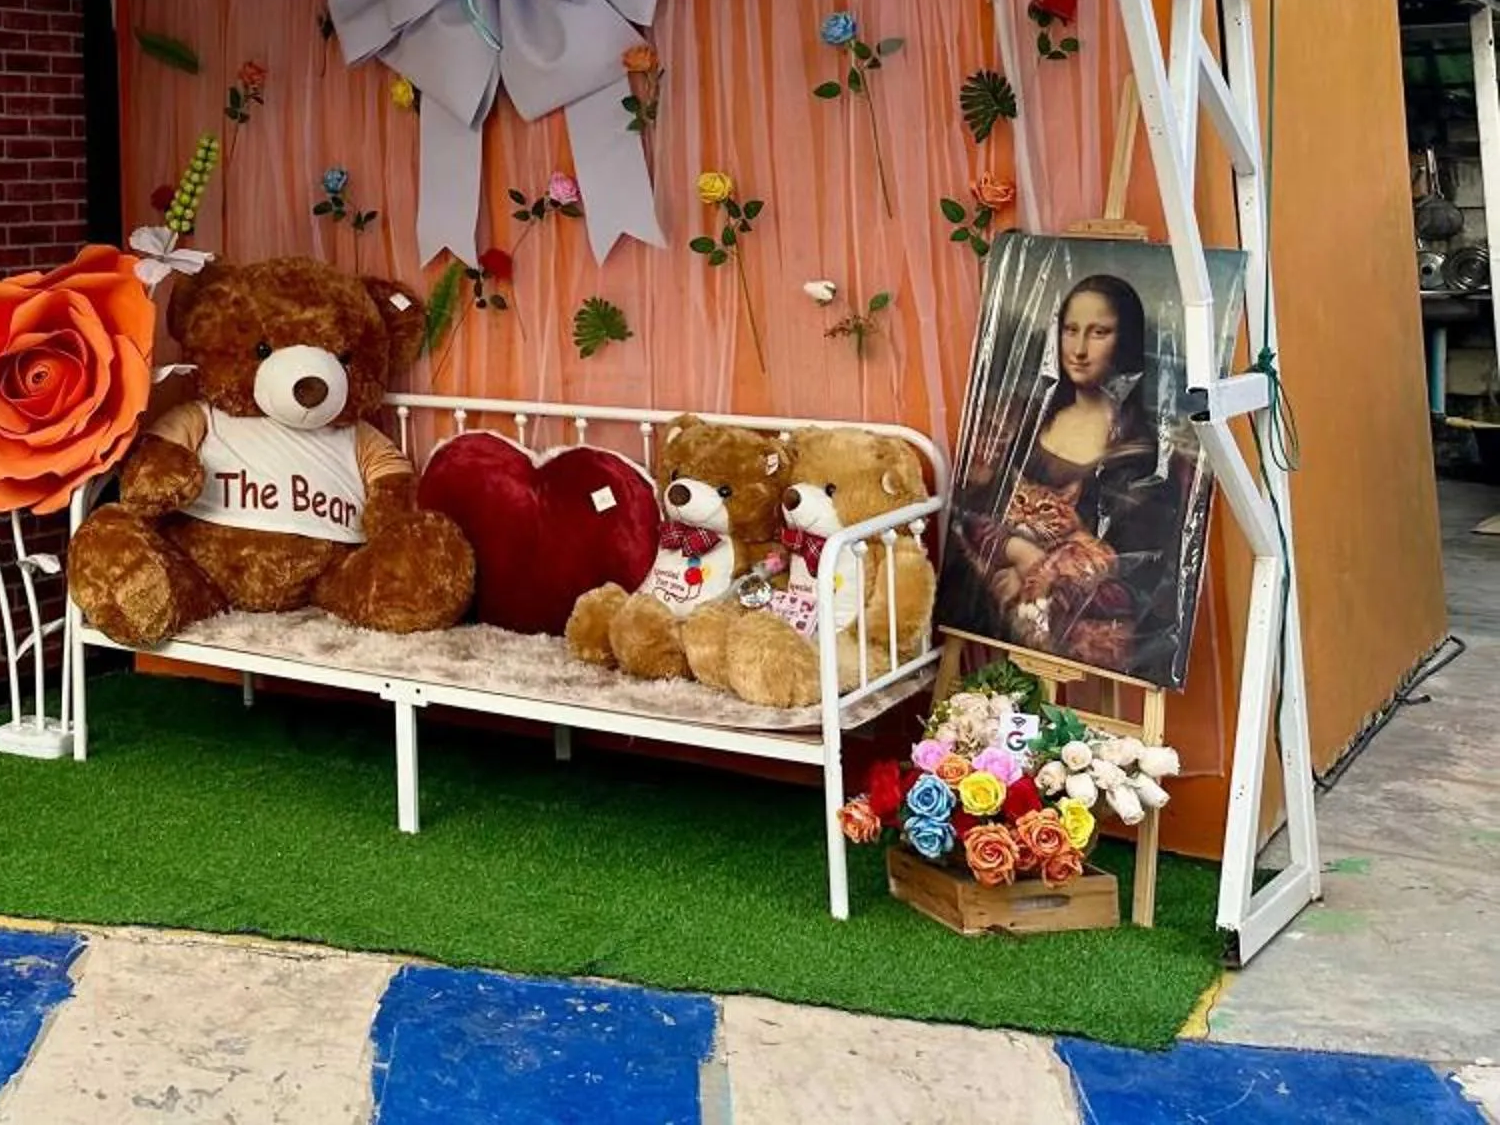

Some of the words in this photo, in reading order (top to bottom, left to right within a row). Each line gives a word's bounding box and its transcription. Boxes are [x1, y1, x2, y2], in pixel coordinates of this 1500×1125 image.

[215, 469, 278, 510] The
[291, 474, 356, 527] Bear
[1006, 730, 1027, 752] G
